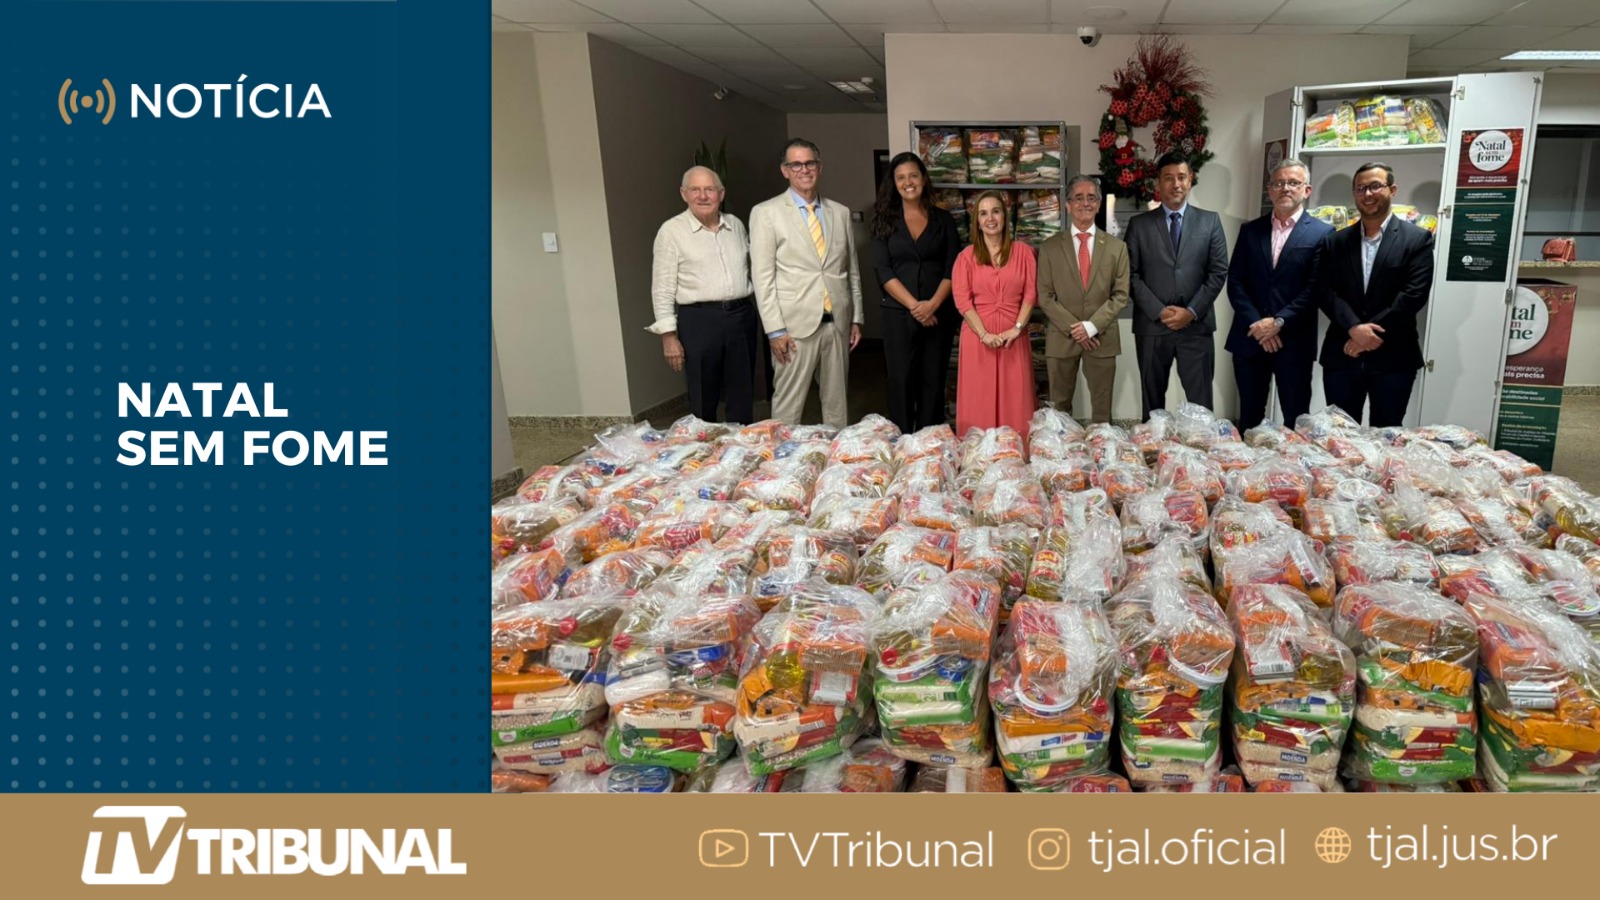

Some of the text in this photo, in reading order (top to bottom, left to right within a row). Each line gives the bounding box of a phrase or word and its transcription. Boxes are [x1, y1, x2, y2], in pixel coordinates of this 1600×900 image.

[1475, 140, 1506, 151] Natal
[1477, 152, 1505, 163] fome
[1511, 303, 1536, 321] tal
